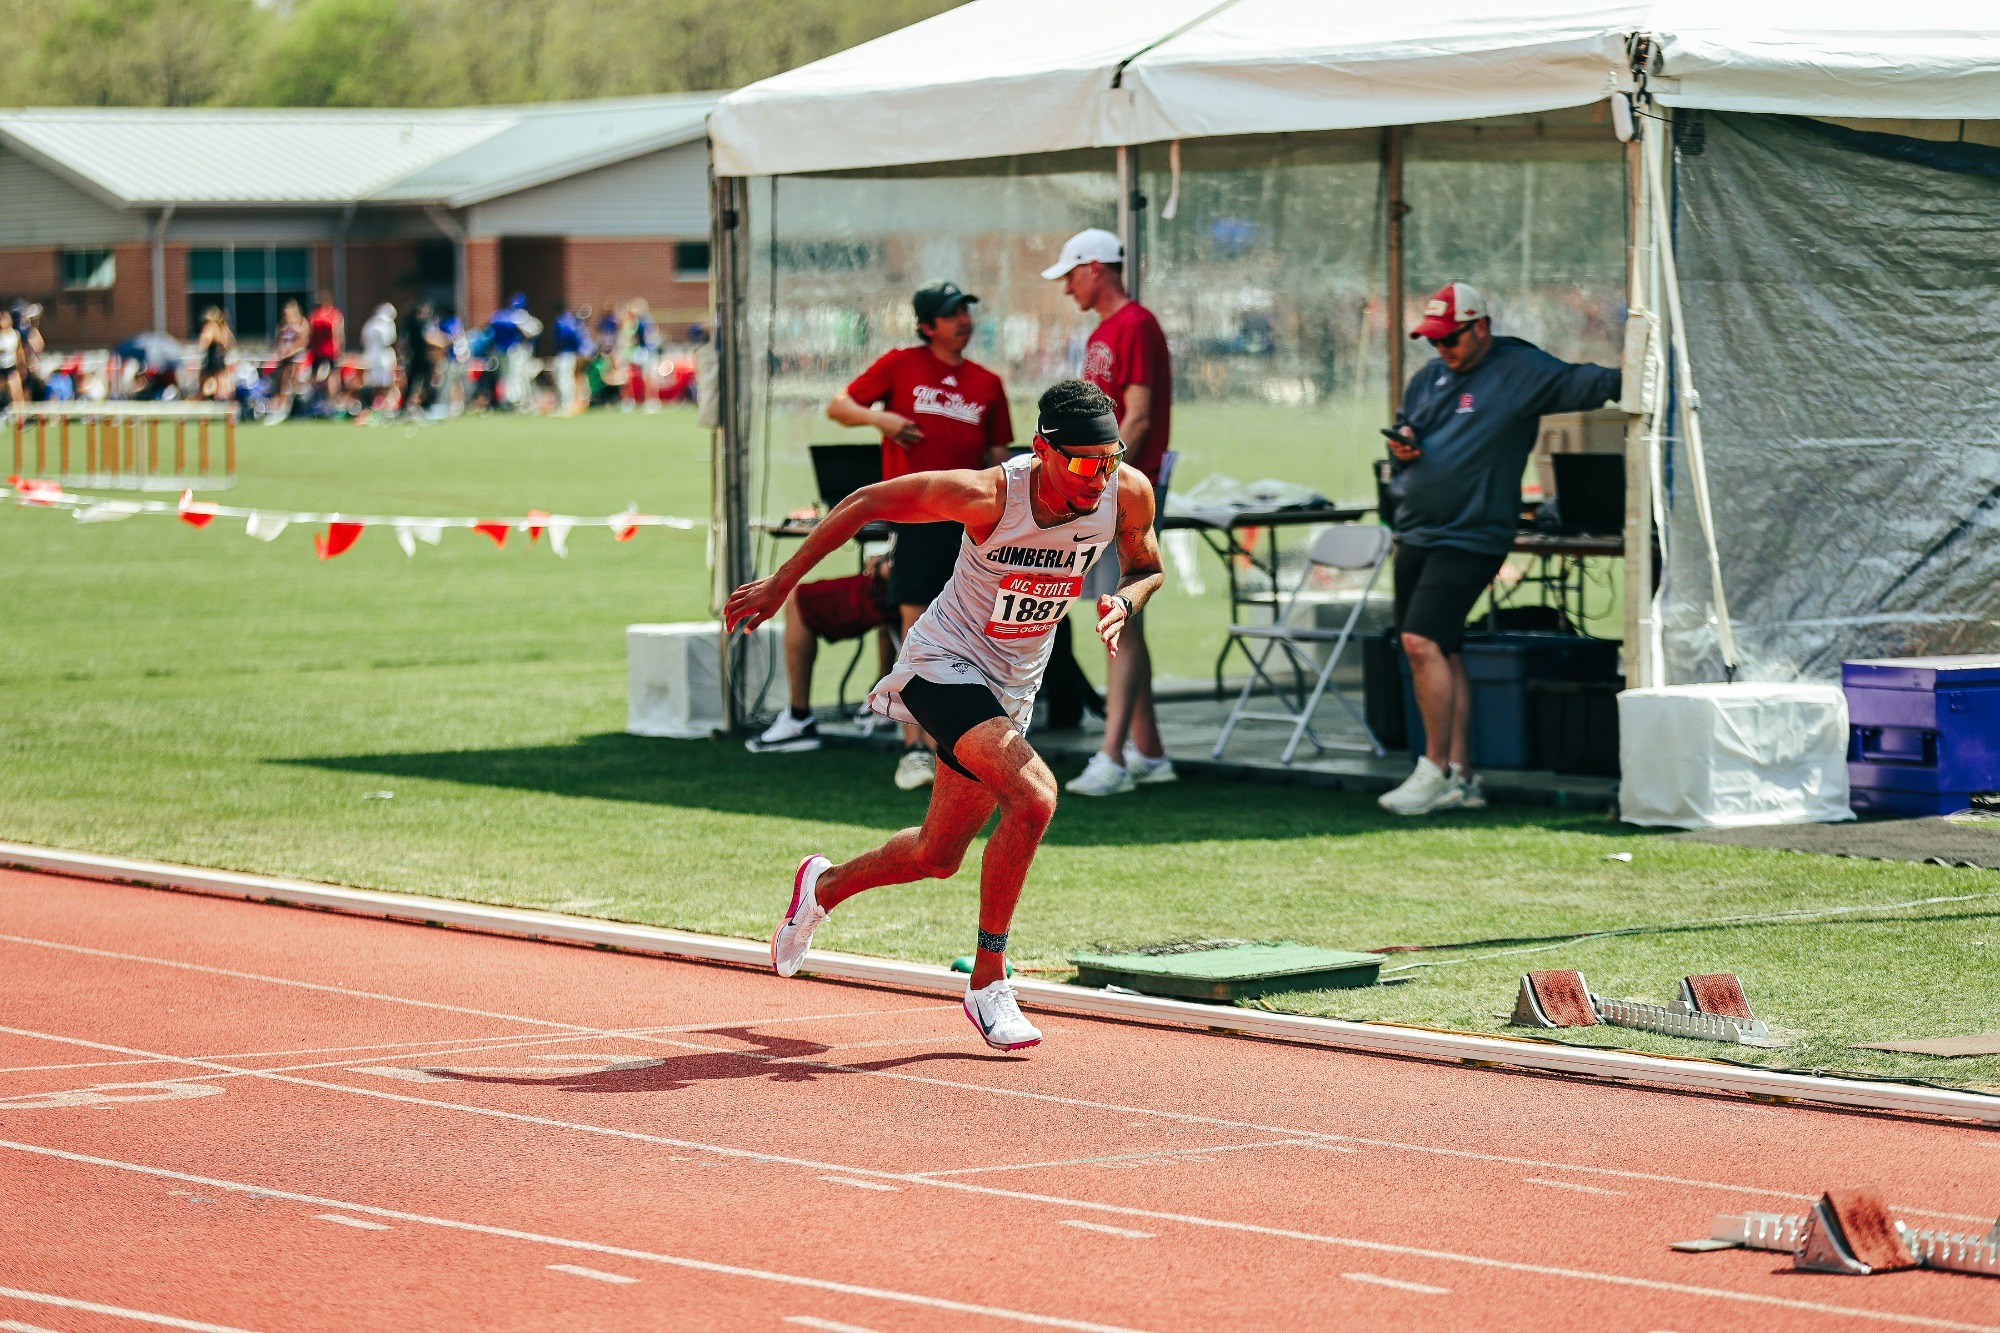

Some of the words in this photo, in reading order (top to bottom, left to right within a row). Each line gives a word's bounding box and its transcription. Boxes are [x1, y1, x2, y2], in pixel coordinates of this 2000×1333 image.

[986, 546, 1076, 569] CUMBERLA
[1080, 545, 1097, 573] 1
[1010, 579, 1032, 592] NC
[1033, 582, 1074, 596] STATE
[1002, 594, 1069, 623] 1881
[1020, 624, 1053, 633] adida
